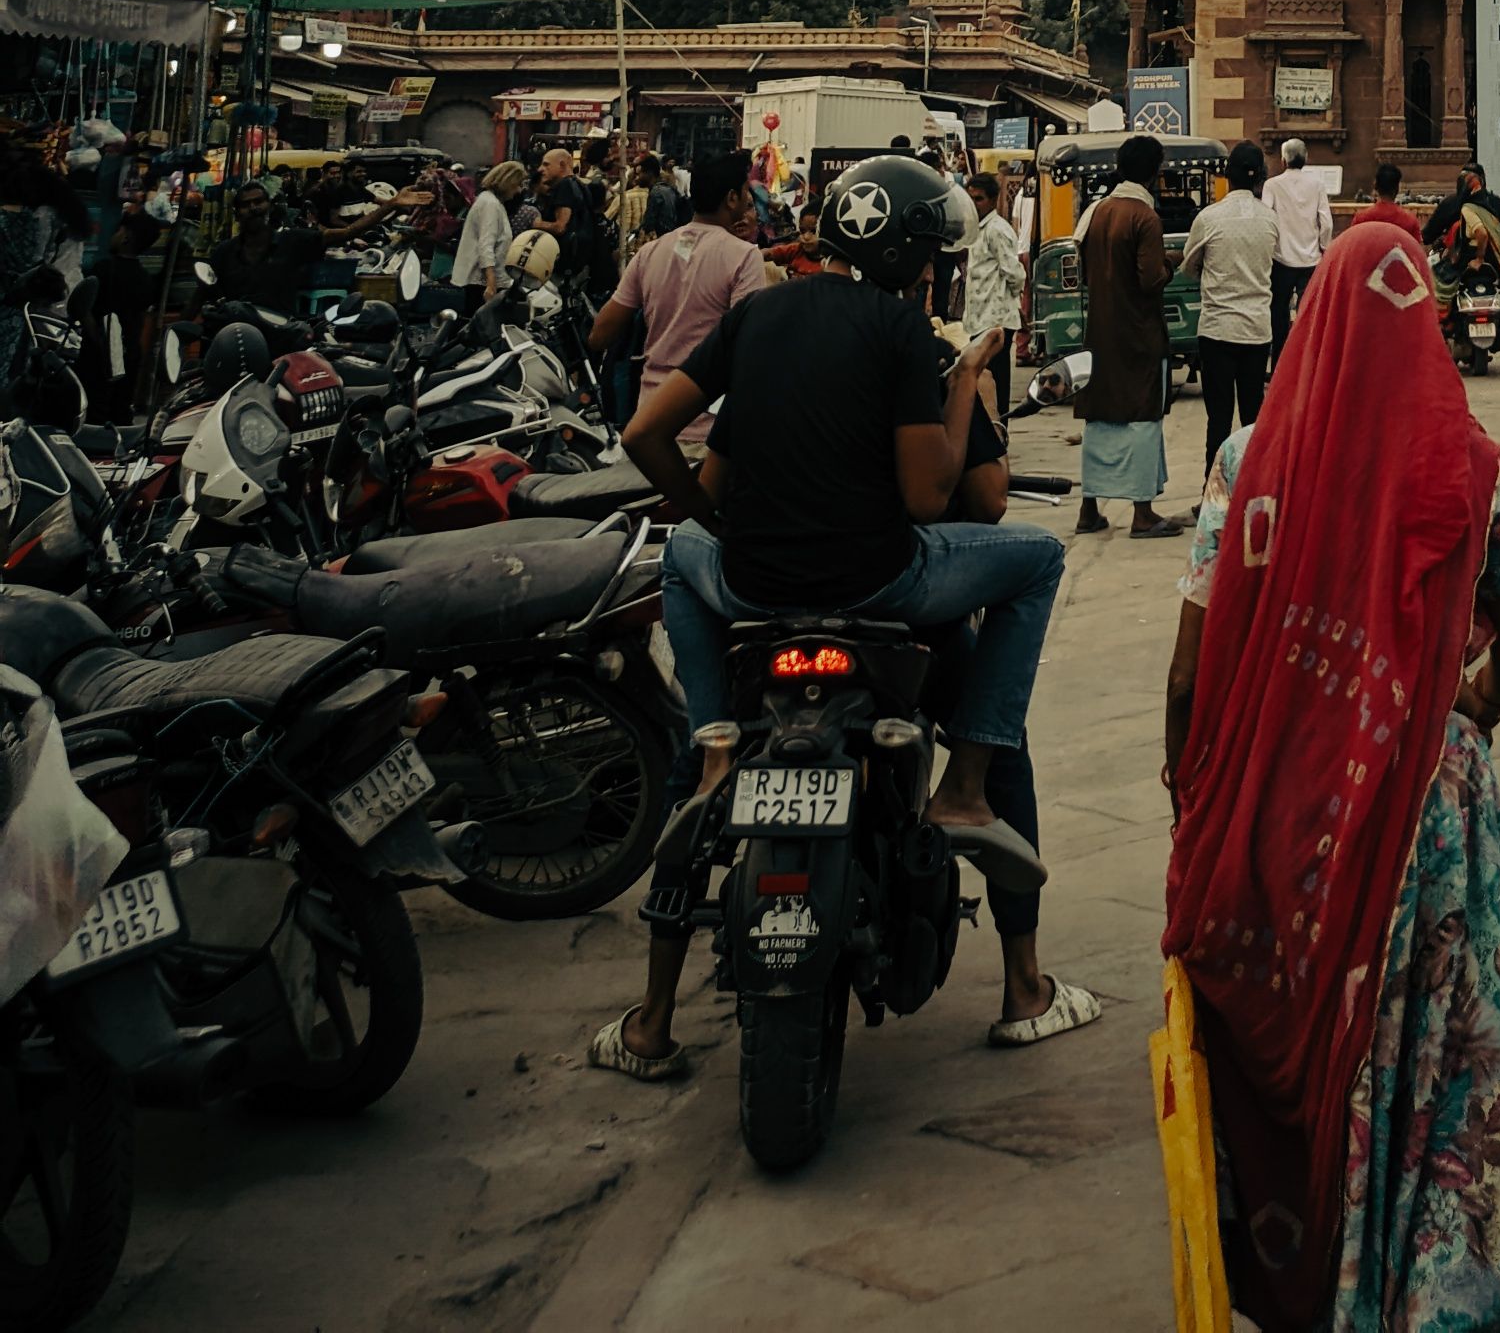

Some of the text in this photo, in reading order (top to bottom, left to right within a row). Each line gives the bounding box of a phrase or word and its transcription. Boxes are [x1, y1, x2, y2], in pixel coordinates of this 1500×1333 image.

[1133, 75, 1173, 83] JODHPUR
[1133, 81, 1181, 90] ARTS WEEK
[756, 770, 838, 795] RJ19D
[367, 773, 426, 827] S4943
[754, 799, 837, 824] C2517
[81, 878, 154, 927] J19D
[78, 907, 164, 961] R2852
[759, 938, 806, 949] NO FARMERS
[765, 953, 776, 964] NO
